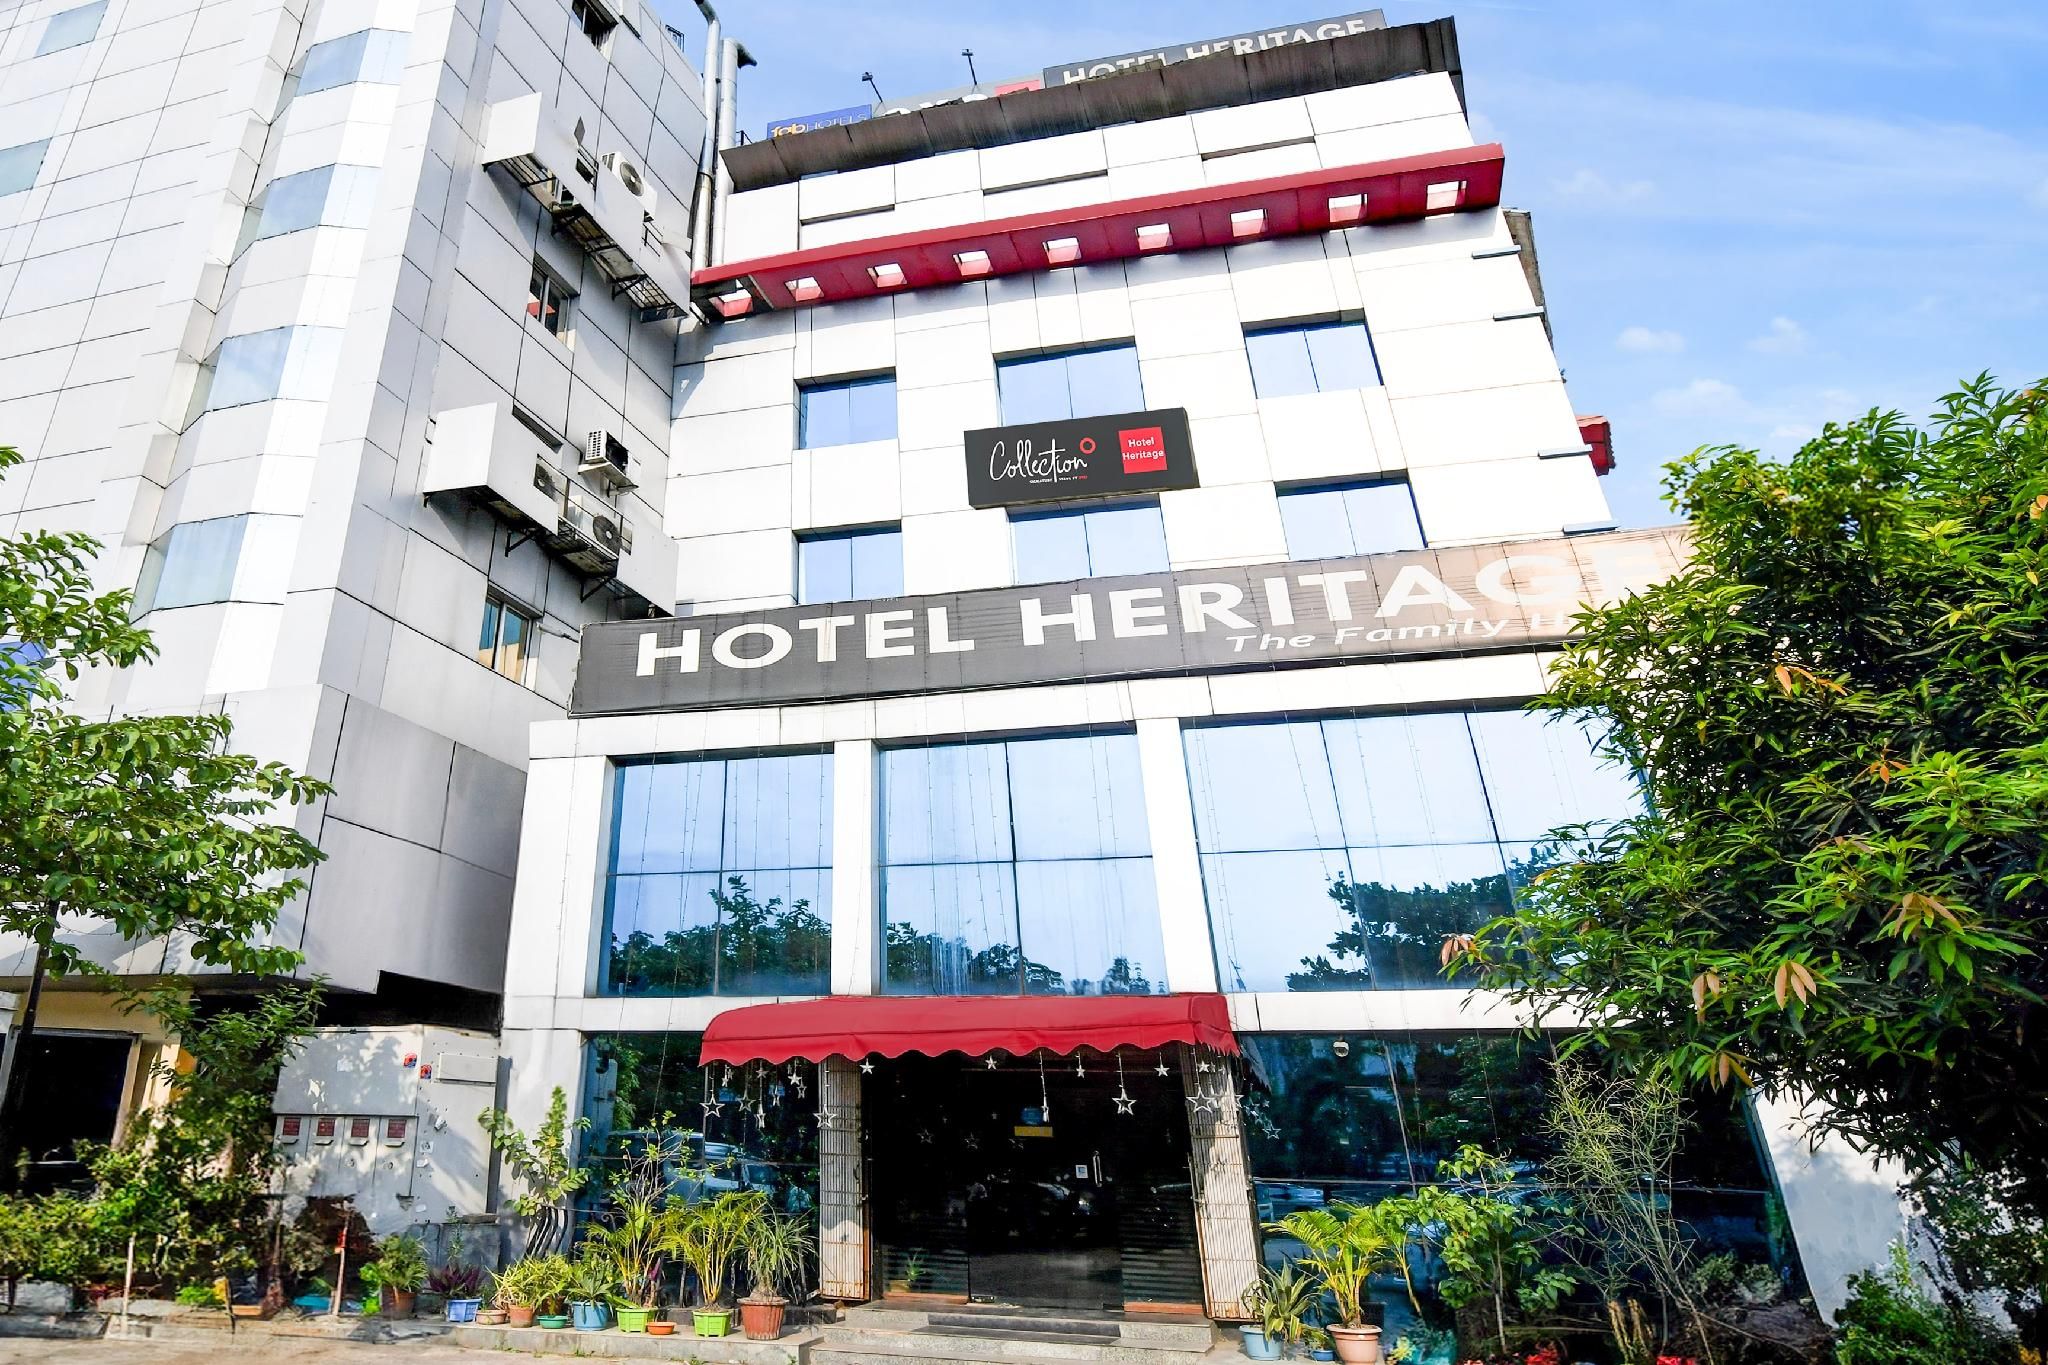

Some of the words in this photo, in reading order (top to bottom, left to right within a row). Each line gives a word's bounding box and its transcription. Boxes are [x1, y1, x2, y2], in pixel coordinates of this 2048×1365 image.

[989, 438, 1088, 483] Collection
[1122, 449, 1165, 461] Heritage
[1128, 436, 1155, 448] Hotel
[635, 606, 976, 677] HOTEL
[1226, 631, 1317, 653] The
[1334, 616, 1509, 646] Family
